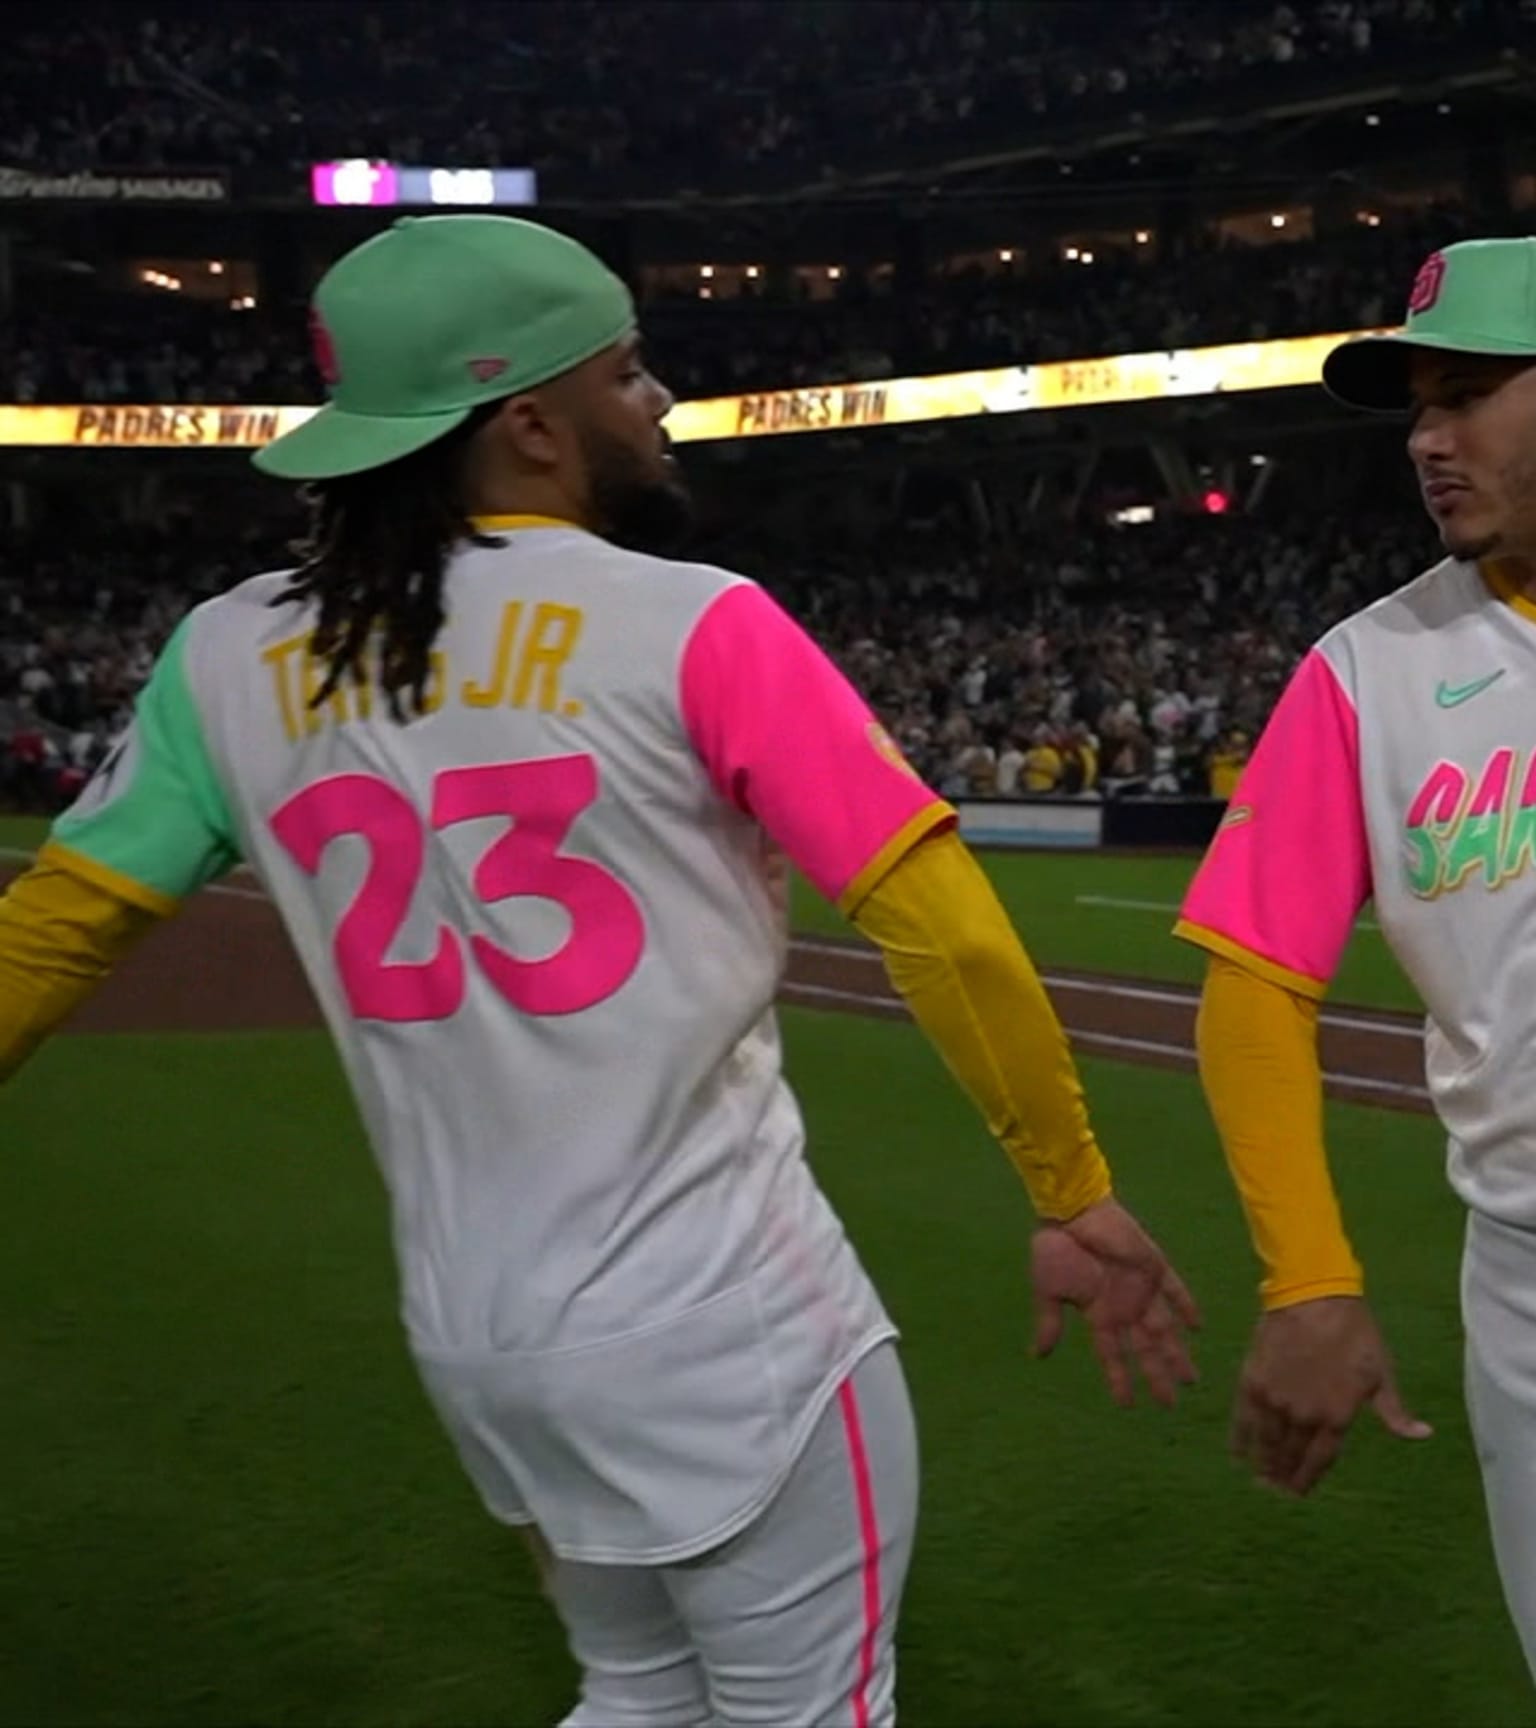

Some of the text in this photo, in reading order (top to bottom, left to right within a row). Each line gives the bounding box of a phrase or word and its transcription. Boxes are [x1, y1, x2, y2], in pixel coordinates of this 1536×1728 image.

[73, 405, 279, 442] PADRES WIN
[736, 387, 889, 435] PADRES WIN
[461, 598, 585, 716] JR.
[267, 752, 647, 1022] 23
